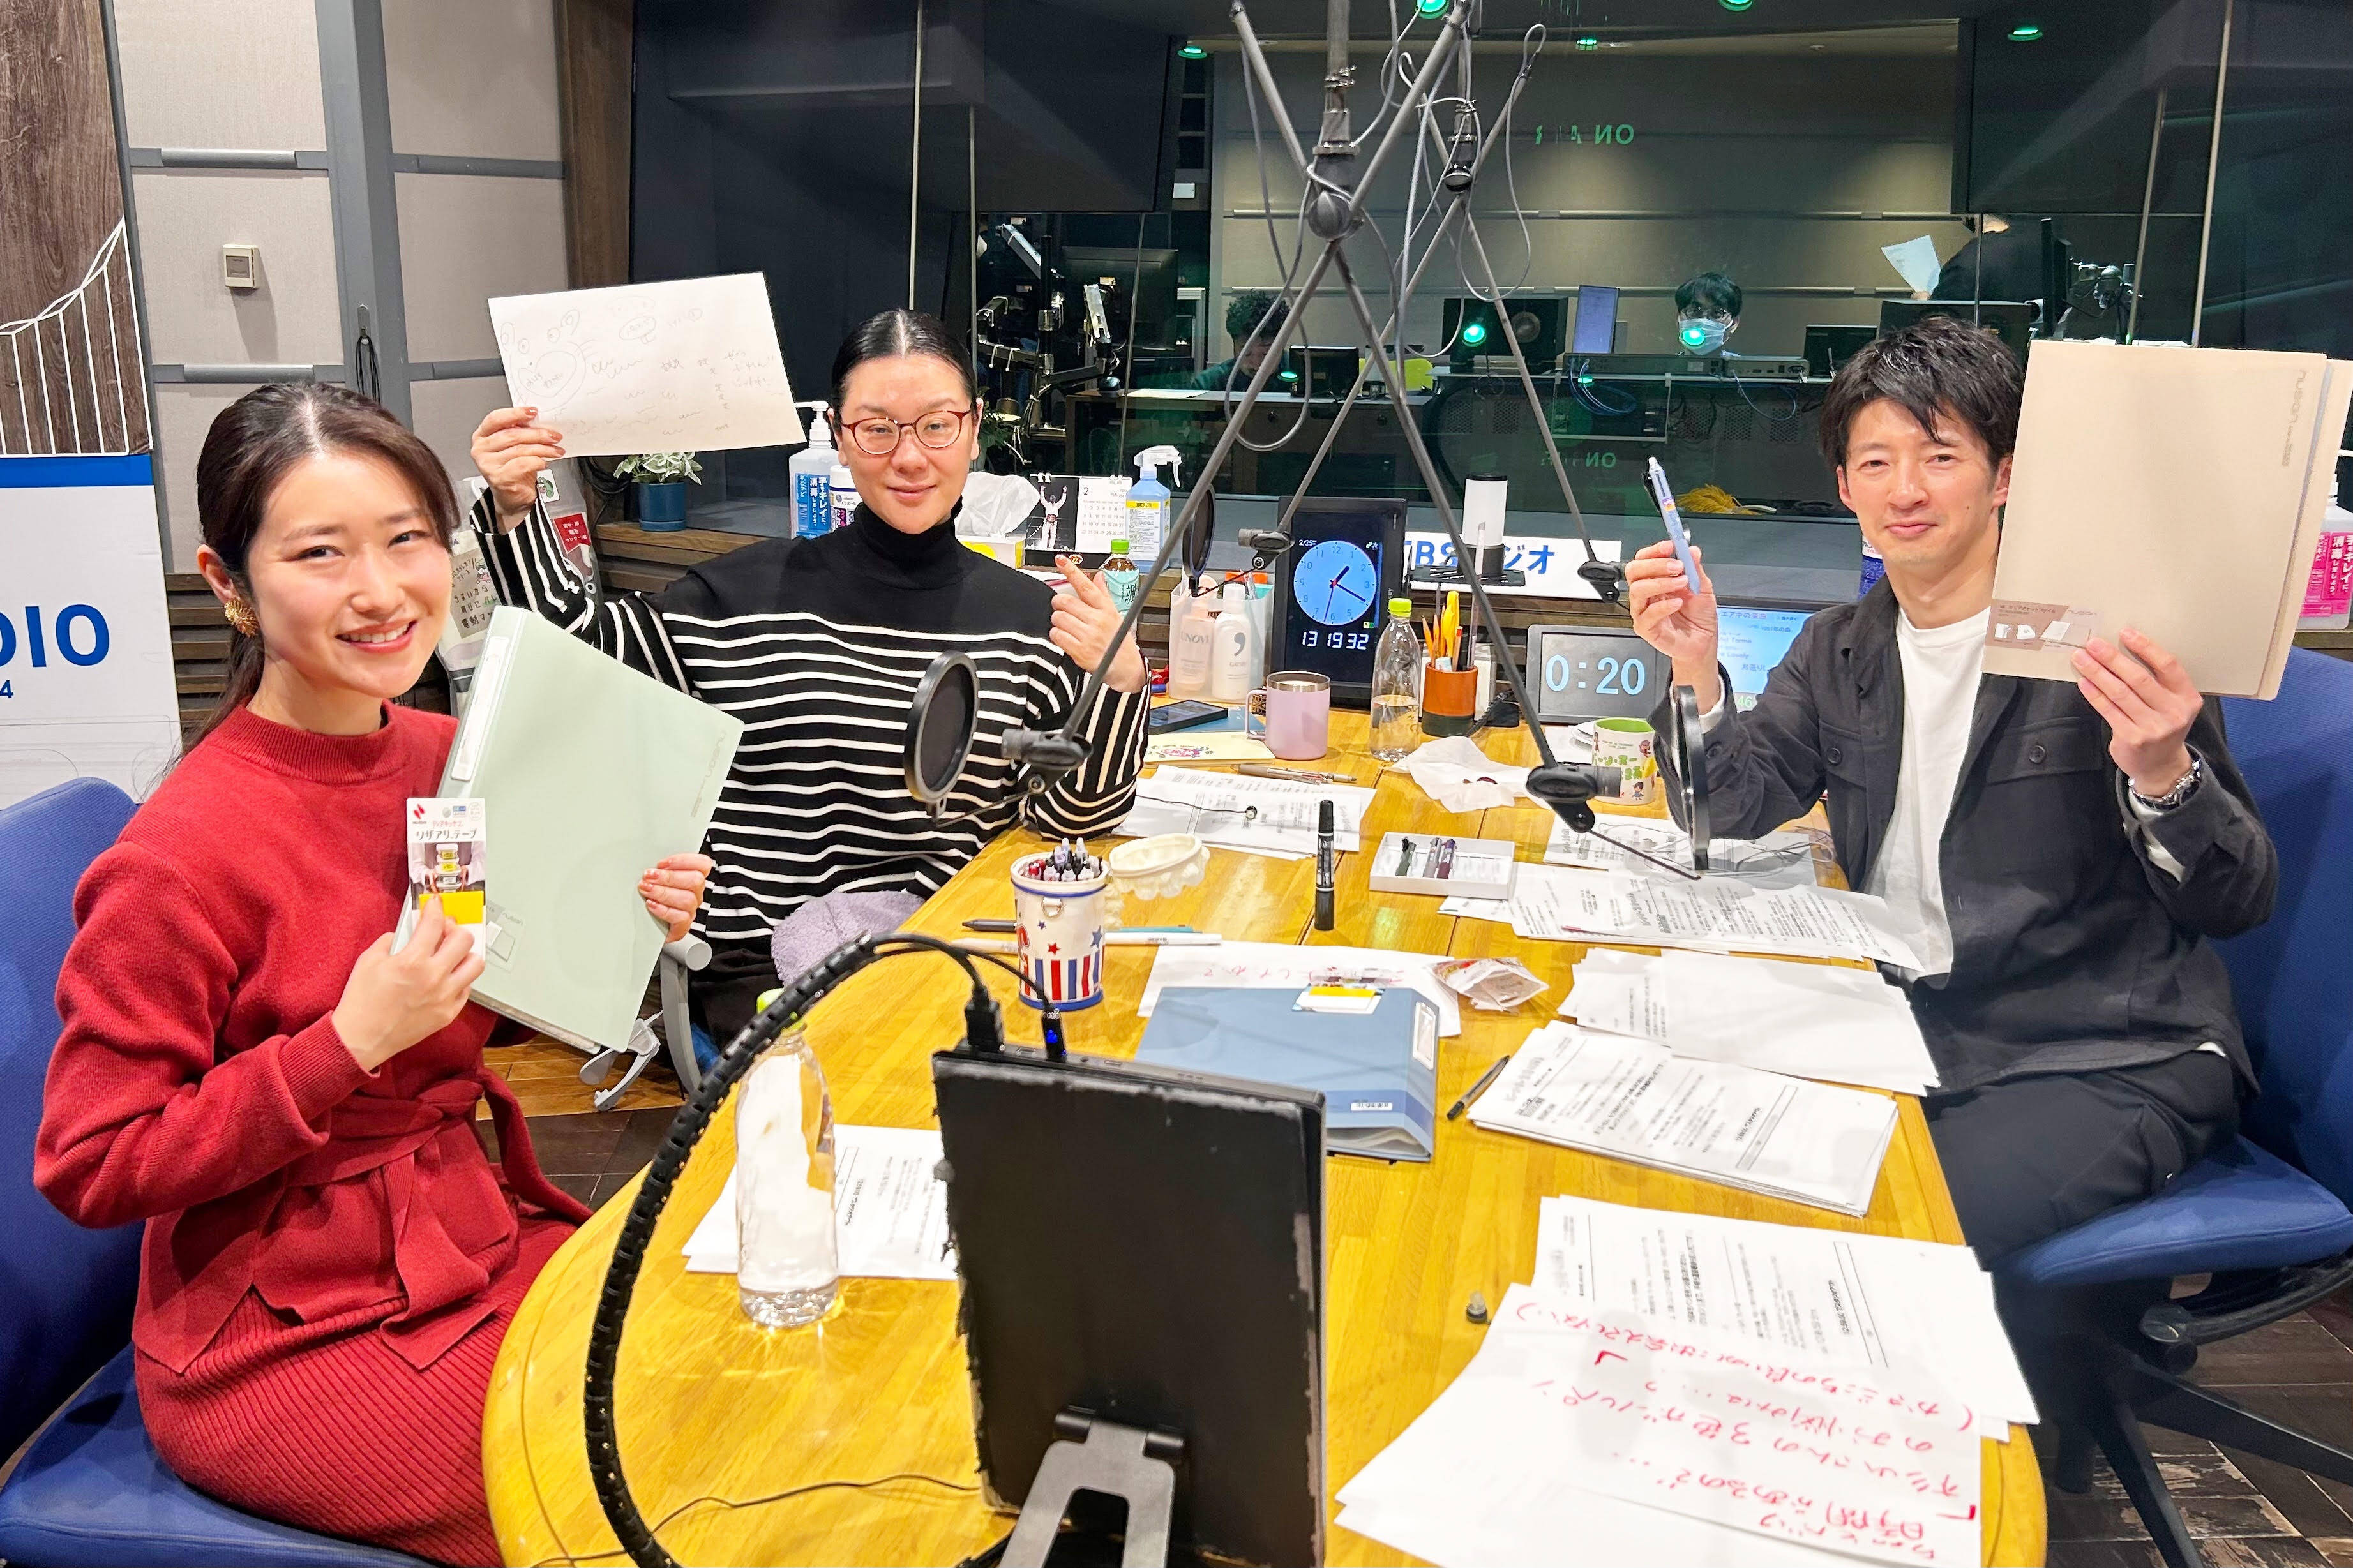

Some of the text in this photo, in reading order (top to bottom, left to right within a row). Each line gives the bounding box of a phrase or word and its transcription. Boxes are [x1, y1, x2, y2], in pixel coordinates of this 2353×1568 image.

[1083, 487, 1089, 495] 2
[1316, 549, 1324, 558] 11
[1332, 546, 1341, 554] 12
[1304, 562, 1312, 570] 10
[1360, 564, 1366, 572] 2
[1313, 607, 1319, 615] 7
[1330, 612, 1335, 620] 6
[1302, 631, 1369, 650] 13 19 32
[1545, 654, 1646, 696] 0:20
